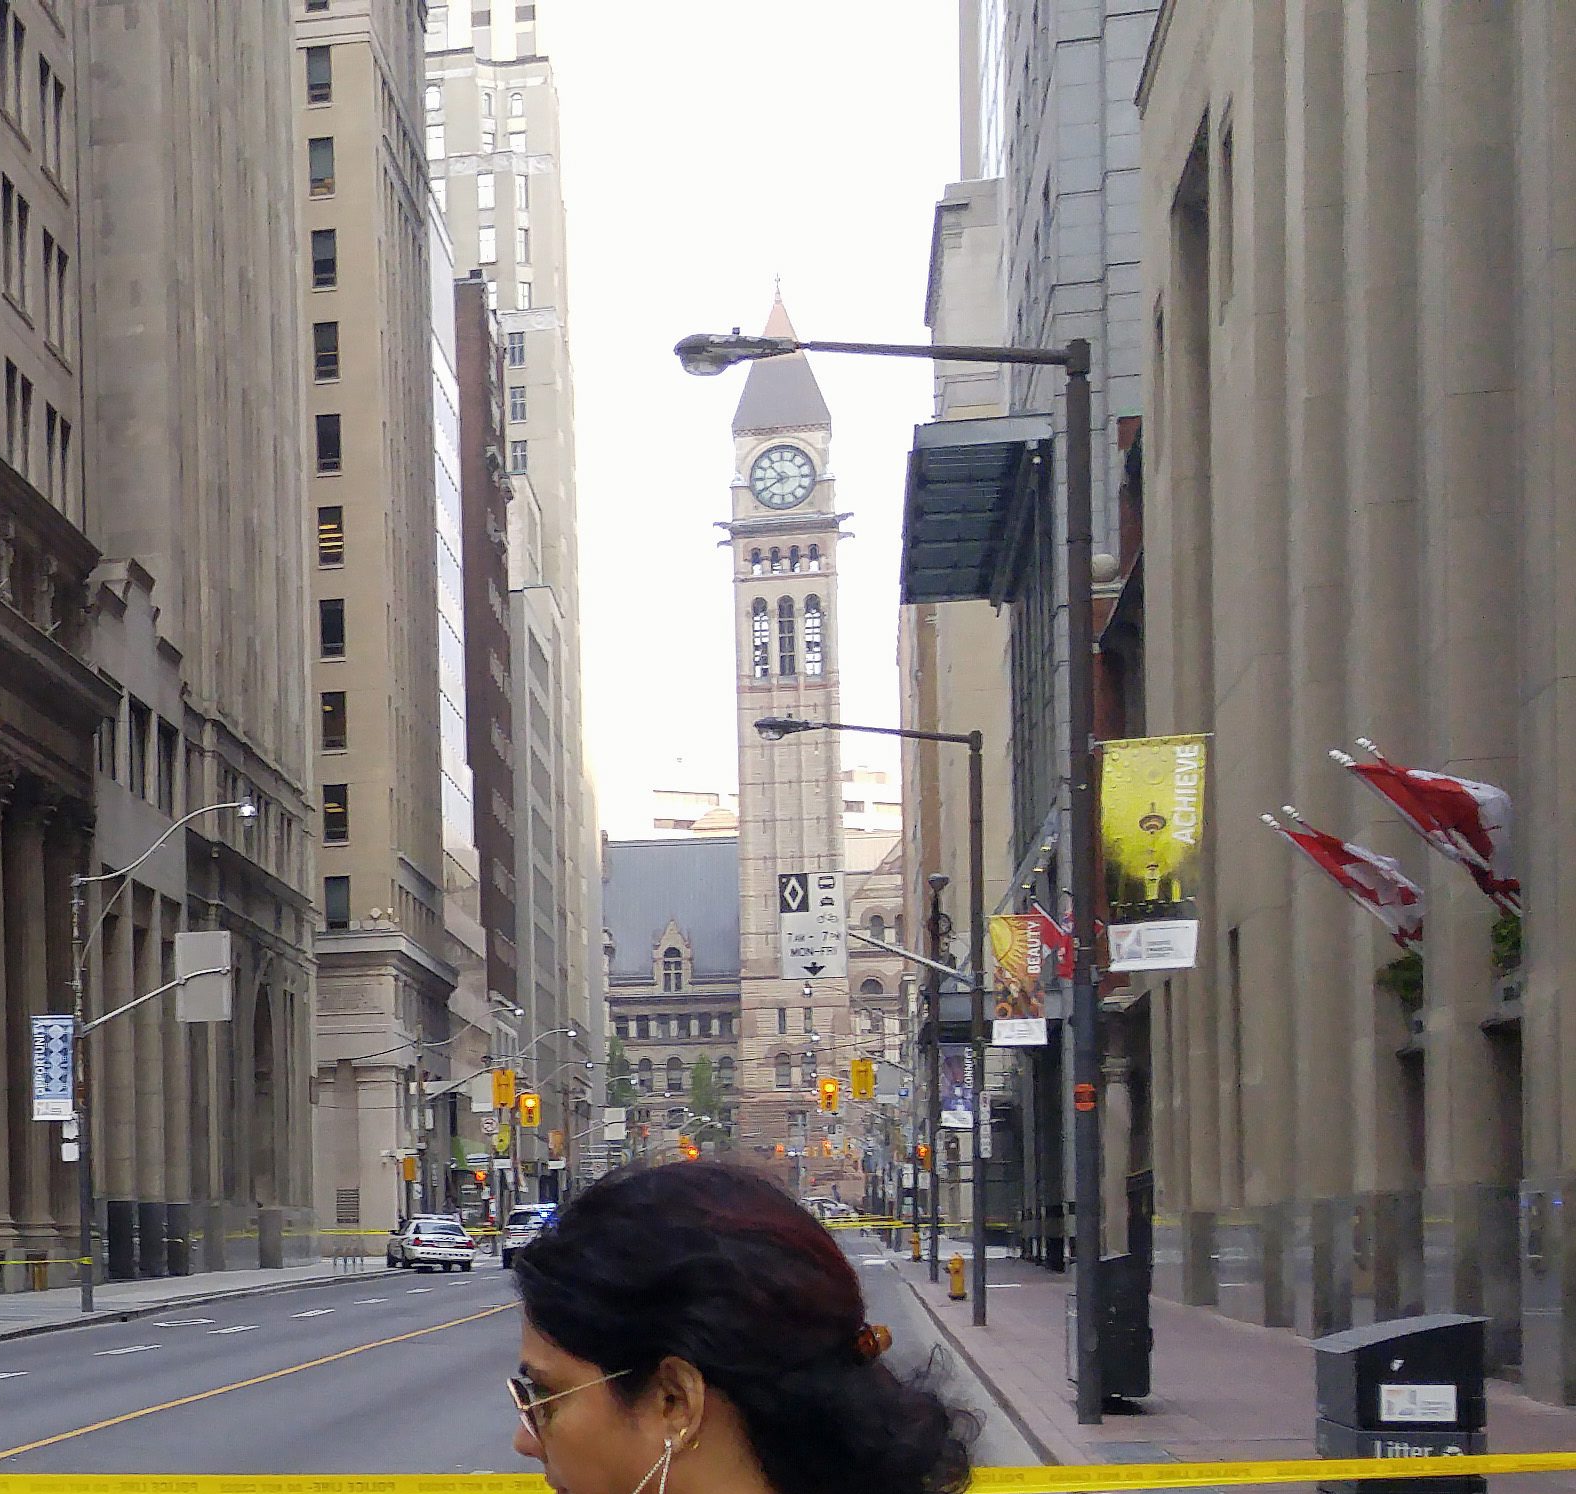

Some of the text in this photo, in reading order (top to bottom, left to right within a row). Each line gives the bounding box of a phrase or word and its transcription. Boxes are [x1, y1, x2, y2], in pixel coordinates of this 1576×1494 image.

[1172, 744, 1199, 845] ACHIEVE
[1026, 920, 1042, 975] BEAUTY
[1373, 1440, 1434, 1459] Litter
